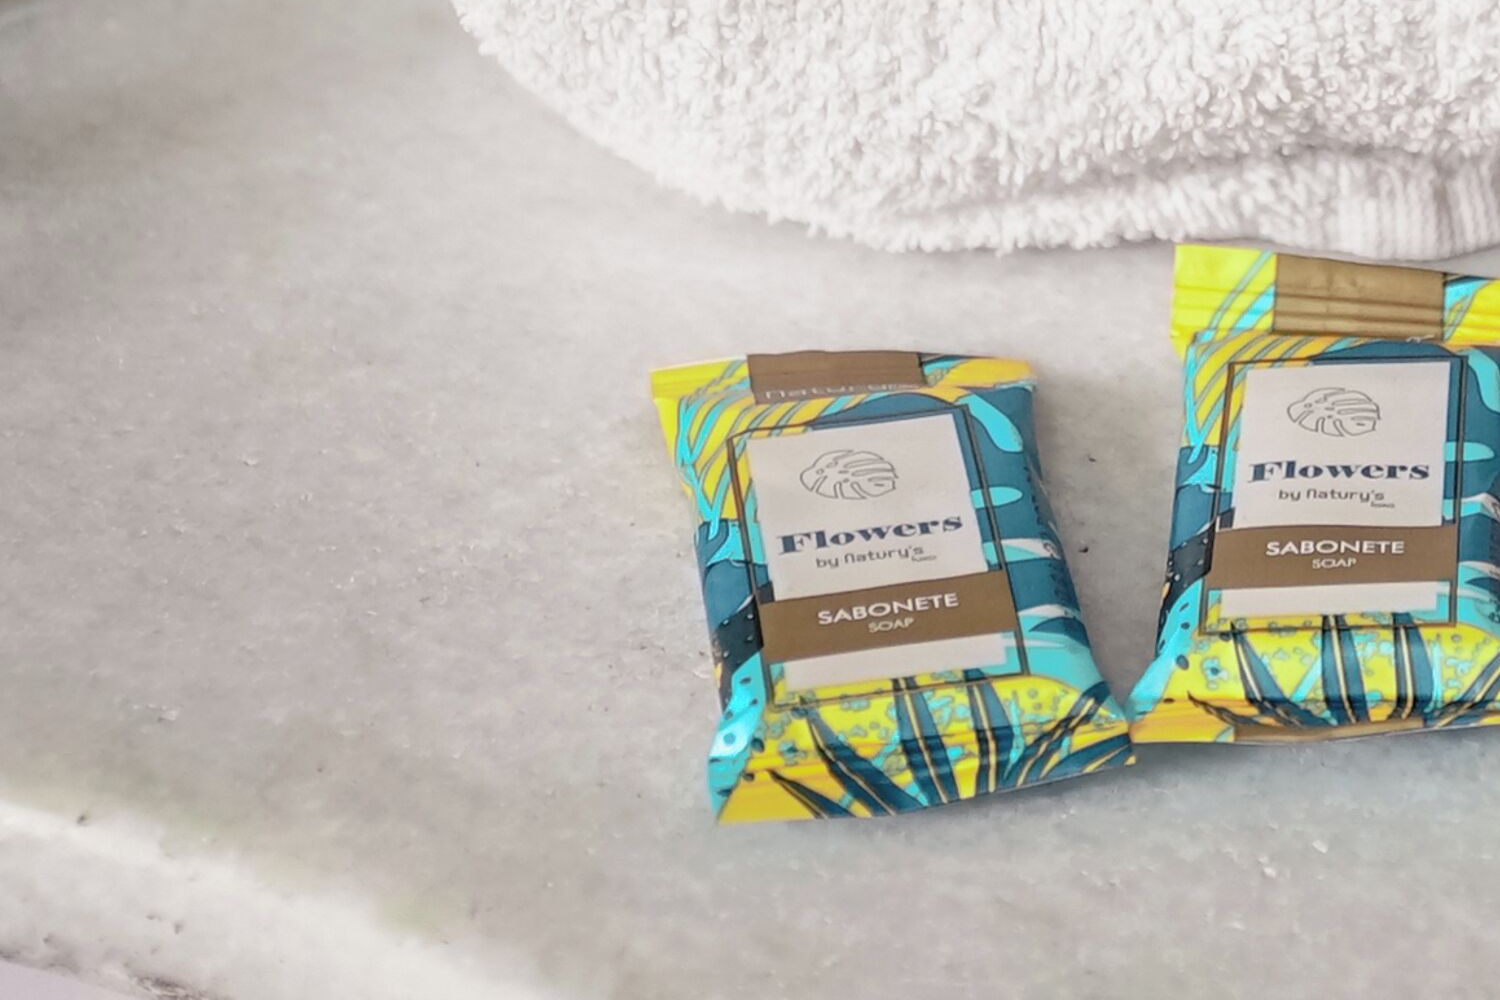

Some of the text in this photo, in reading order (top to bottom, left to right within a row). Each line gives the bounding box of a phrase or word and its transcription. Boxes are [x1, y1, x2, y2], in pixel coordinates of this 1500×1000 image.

[1248, 460, 1430, 483] Flowers
[1278, 489, 1301, 501] by
[777, 516, 964, 556] Flowers
[1265, 540, 1405, 556] SABONETE
[816, 557, 839, 569] by
[1312, 557, 1357, 569] SOAP
[817, 593, 959, 625] SABONETE
[868, 617, 914, 633] SOAP
